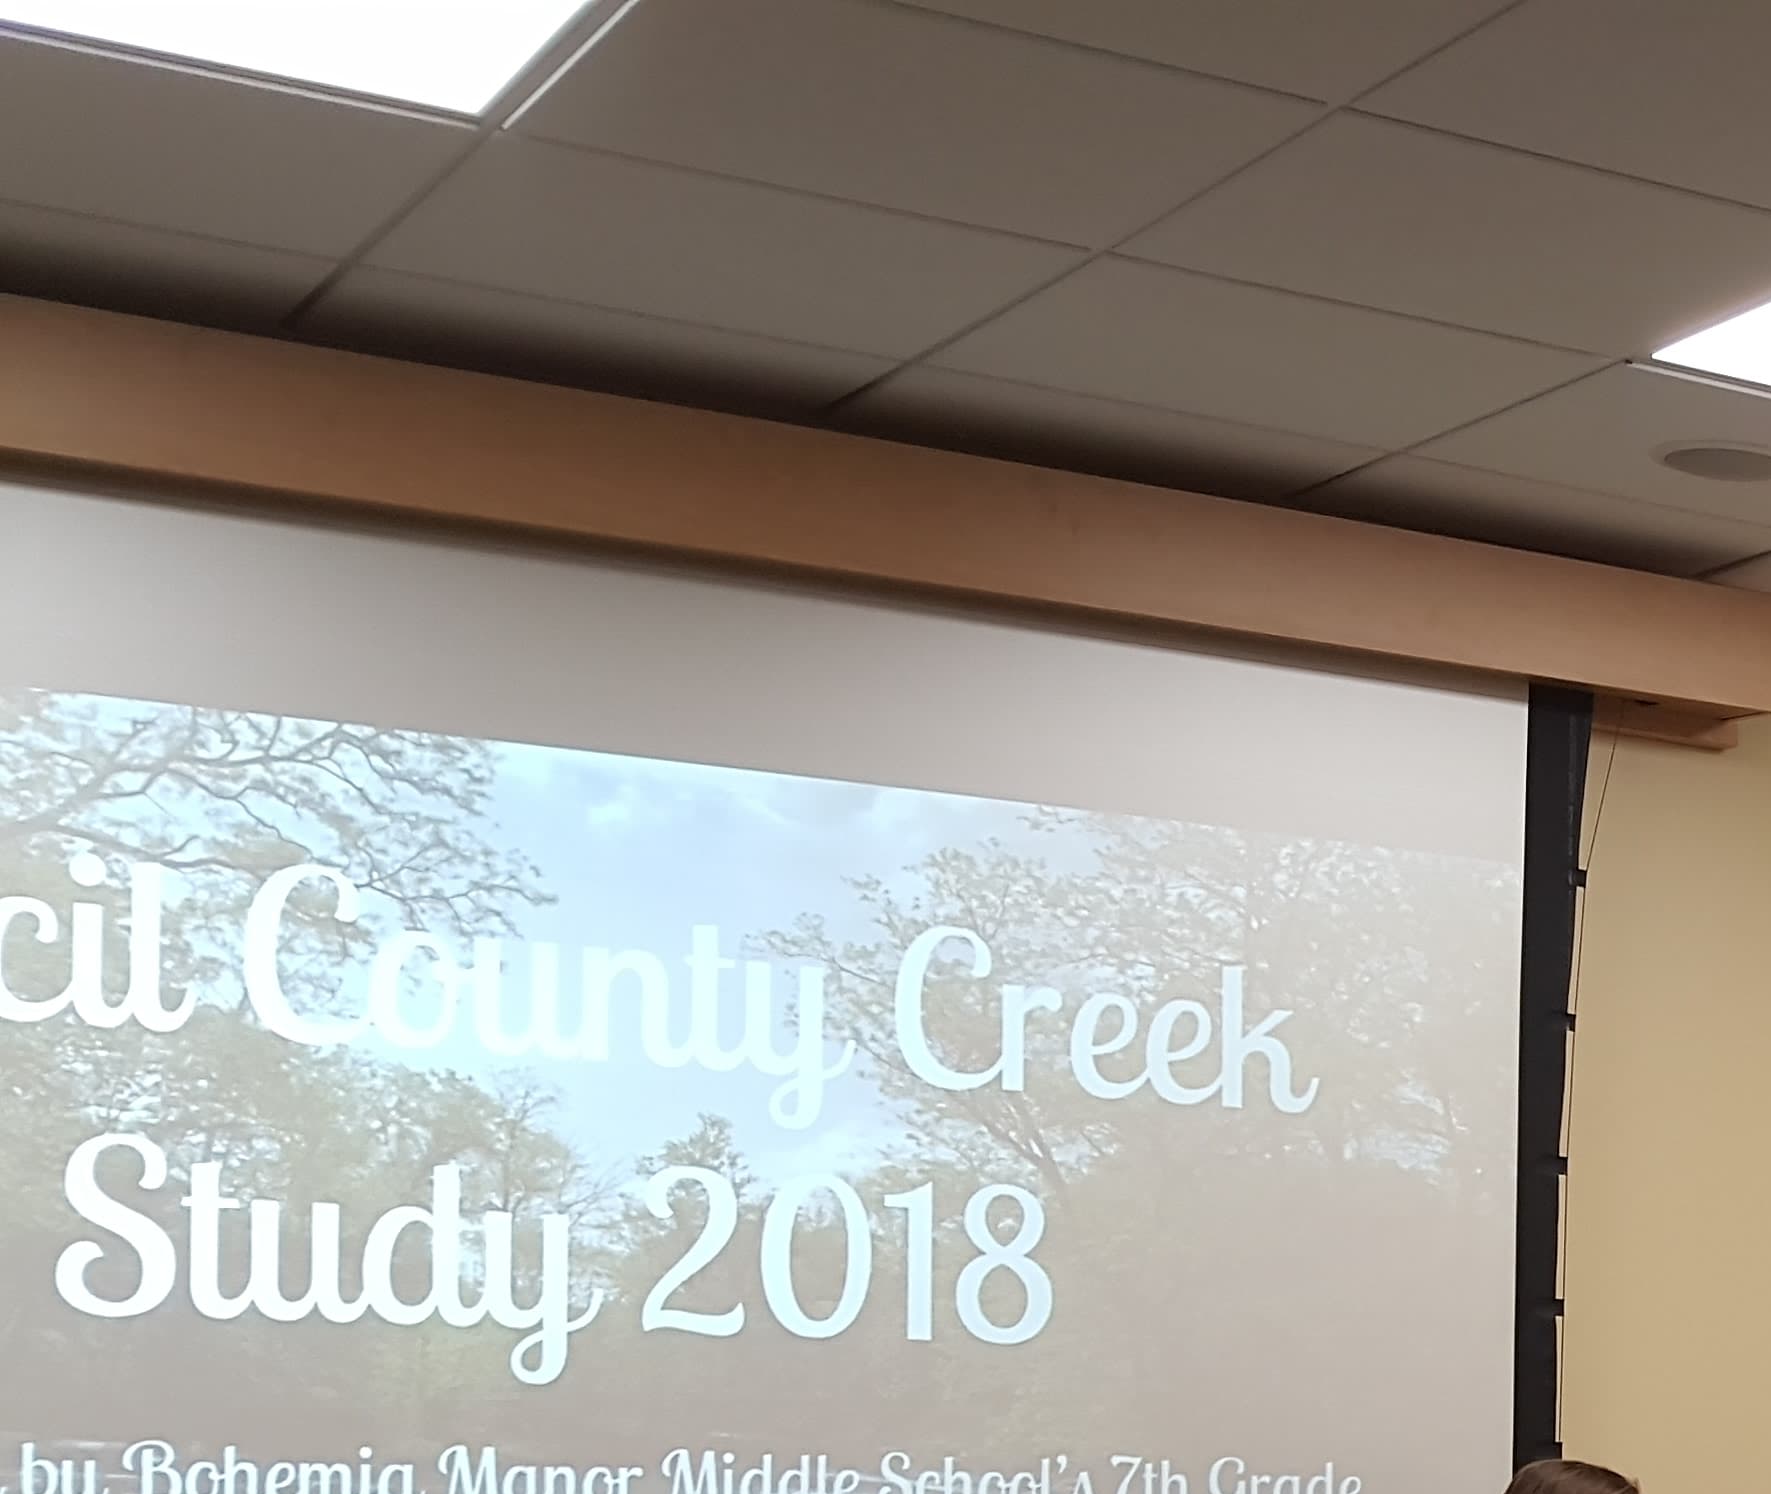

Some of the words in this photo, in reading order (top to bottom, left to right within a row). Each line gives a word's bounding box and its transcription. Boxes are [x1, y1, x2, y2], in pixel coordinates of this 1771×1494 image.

[243, 862, 857, 1130] County
[894, 925, 1320, 1114] Creek
[55, 1132, 603, 1385] Study
[641, 1165, 1053, 1345] 2018
